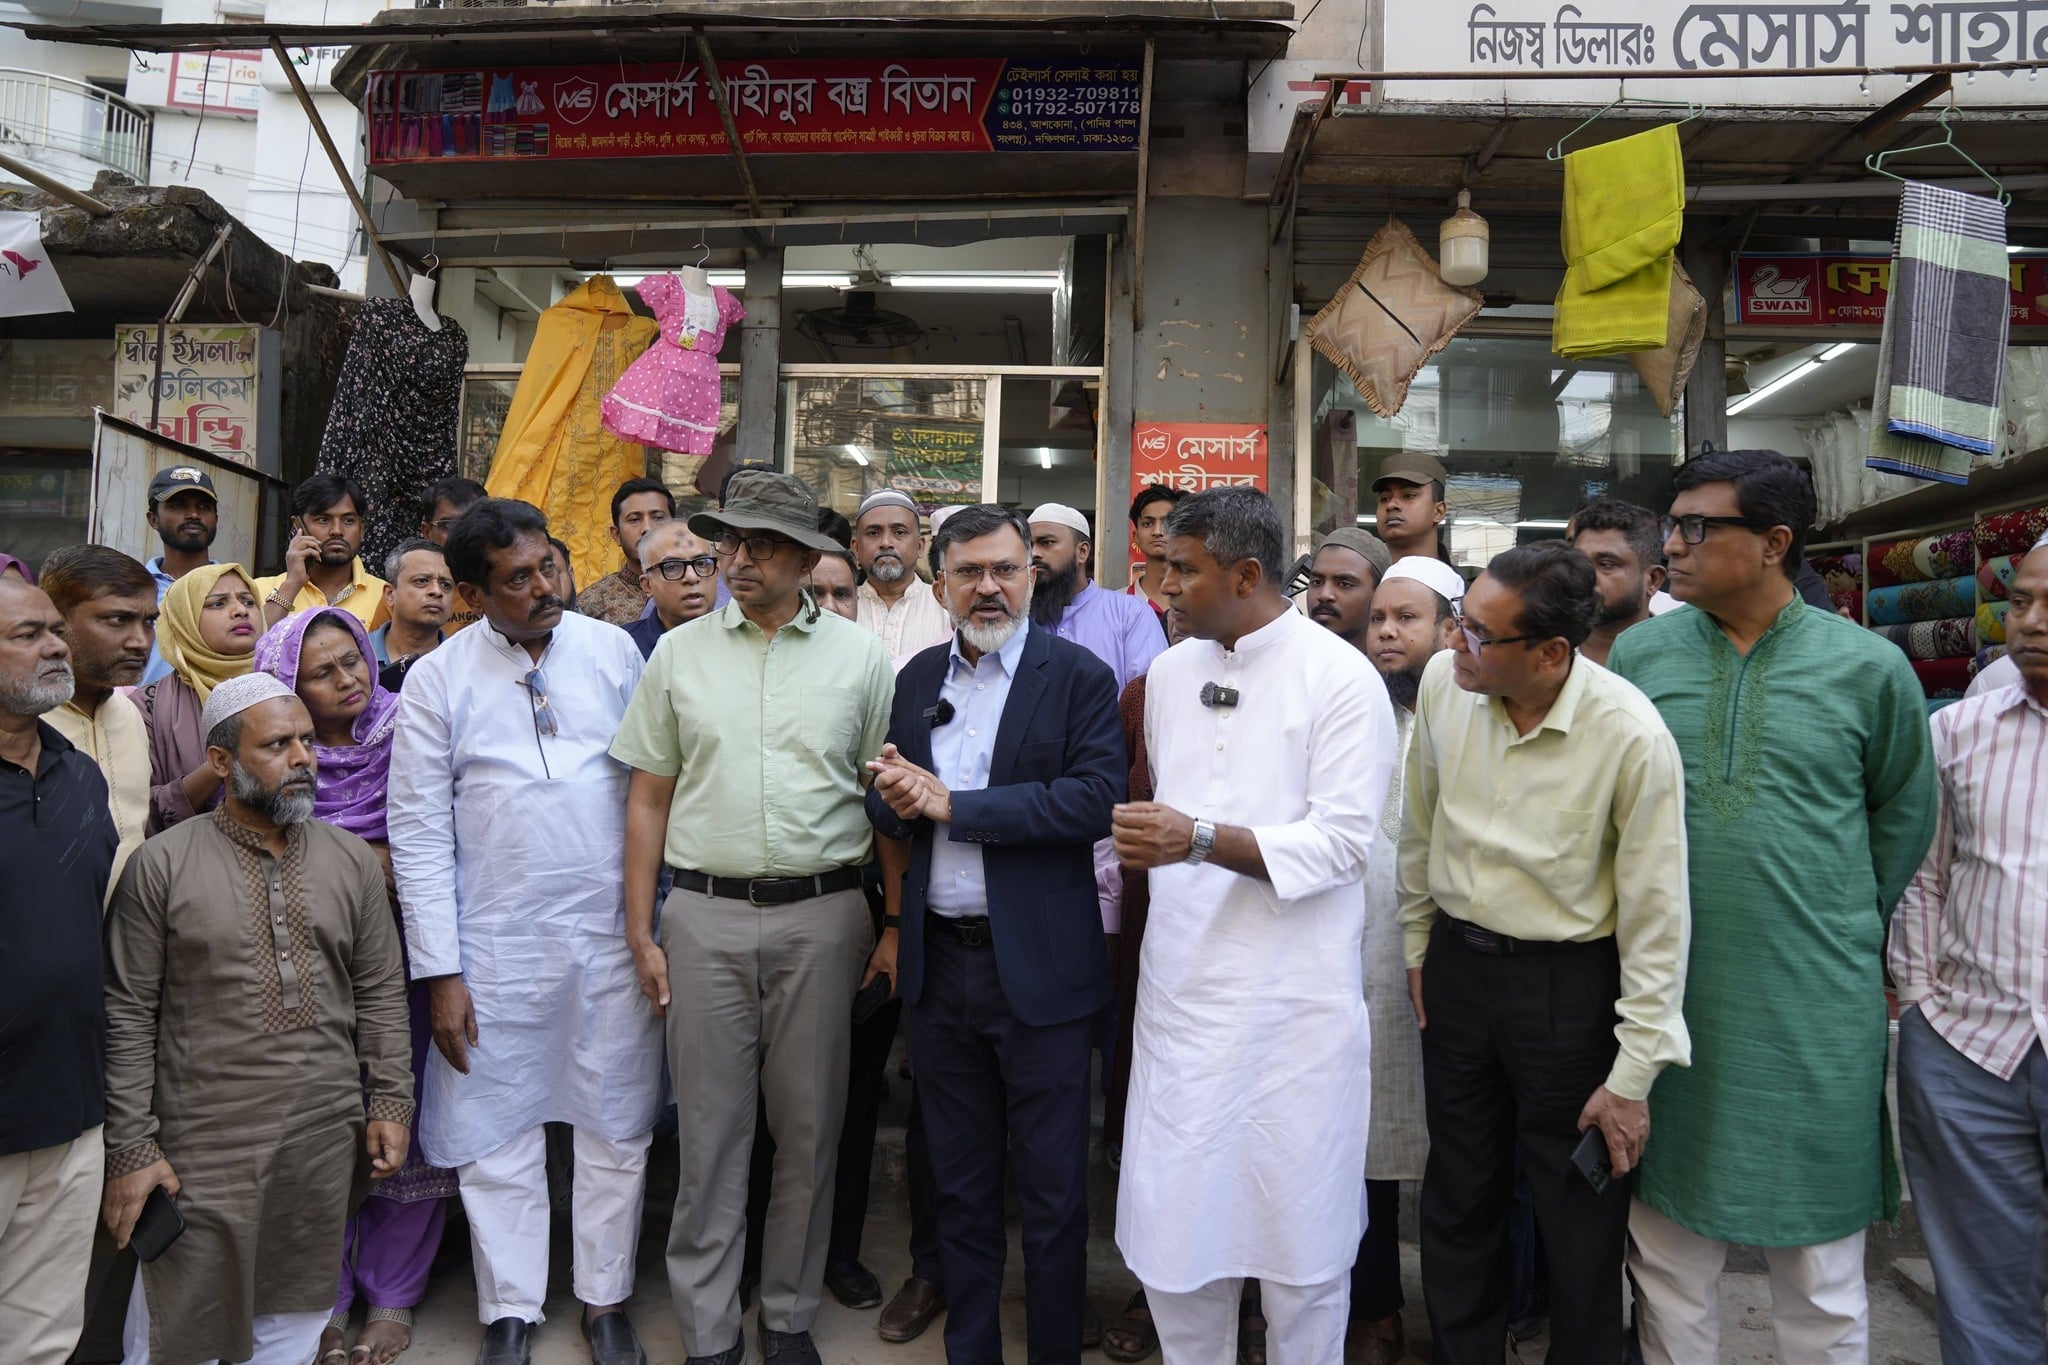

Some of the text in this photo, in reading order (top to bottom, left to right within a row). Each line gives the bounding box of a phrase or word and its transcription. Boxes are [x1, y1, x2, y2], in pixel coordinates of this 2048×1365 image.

[1467, 3, 1547, 70] নিজস্ব
[1553, 4, 1656, 66] ডিলারঃ
[1673, 0, 1872, 70] মেসার্স
[235, 65, 257, 79] ria
[1006, 65, 1052, 83] টেইলার্স
[1054, 67, 1091, 83] সেলাই
[1095, 69, 1117, 82] করা
[605, 66, 701, 119] মেসার্স
[823, 76, 873, 117] বস্ত্র
[879, 63, 977, 116] বিতান
[1012, 86, 1140, 101] 01932-709811
[1012, 101, 1141, 116] 01792-507178
[1752, 299, 1809, 312] SWAN
[1177, 428, 1261, 462] মেসার্স
